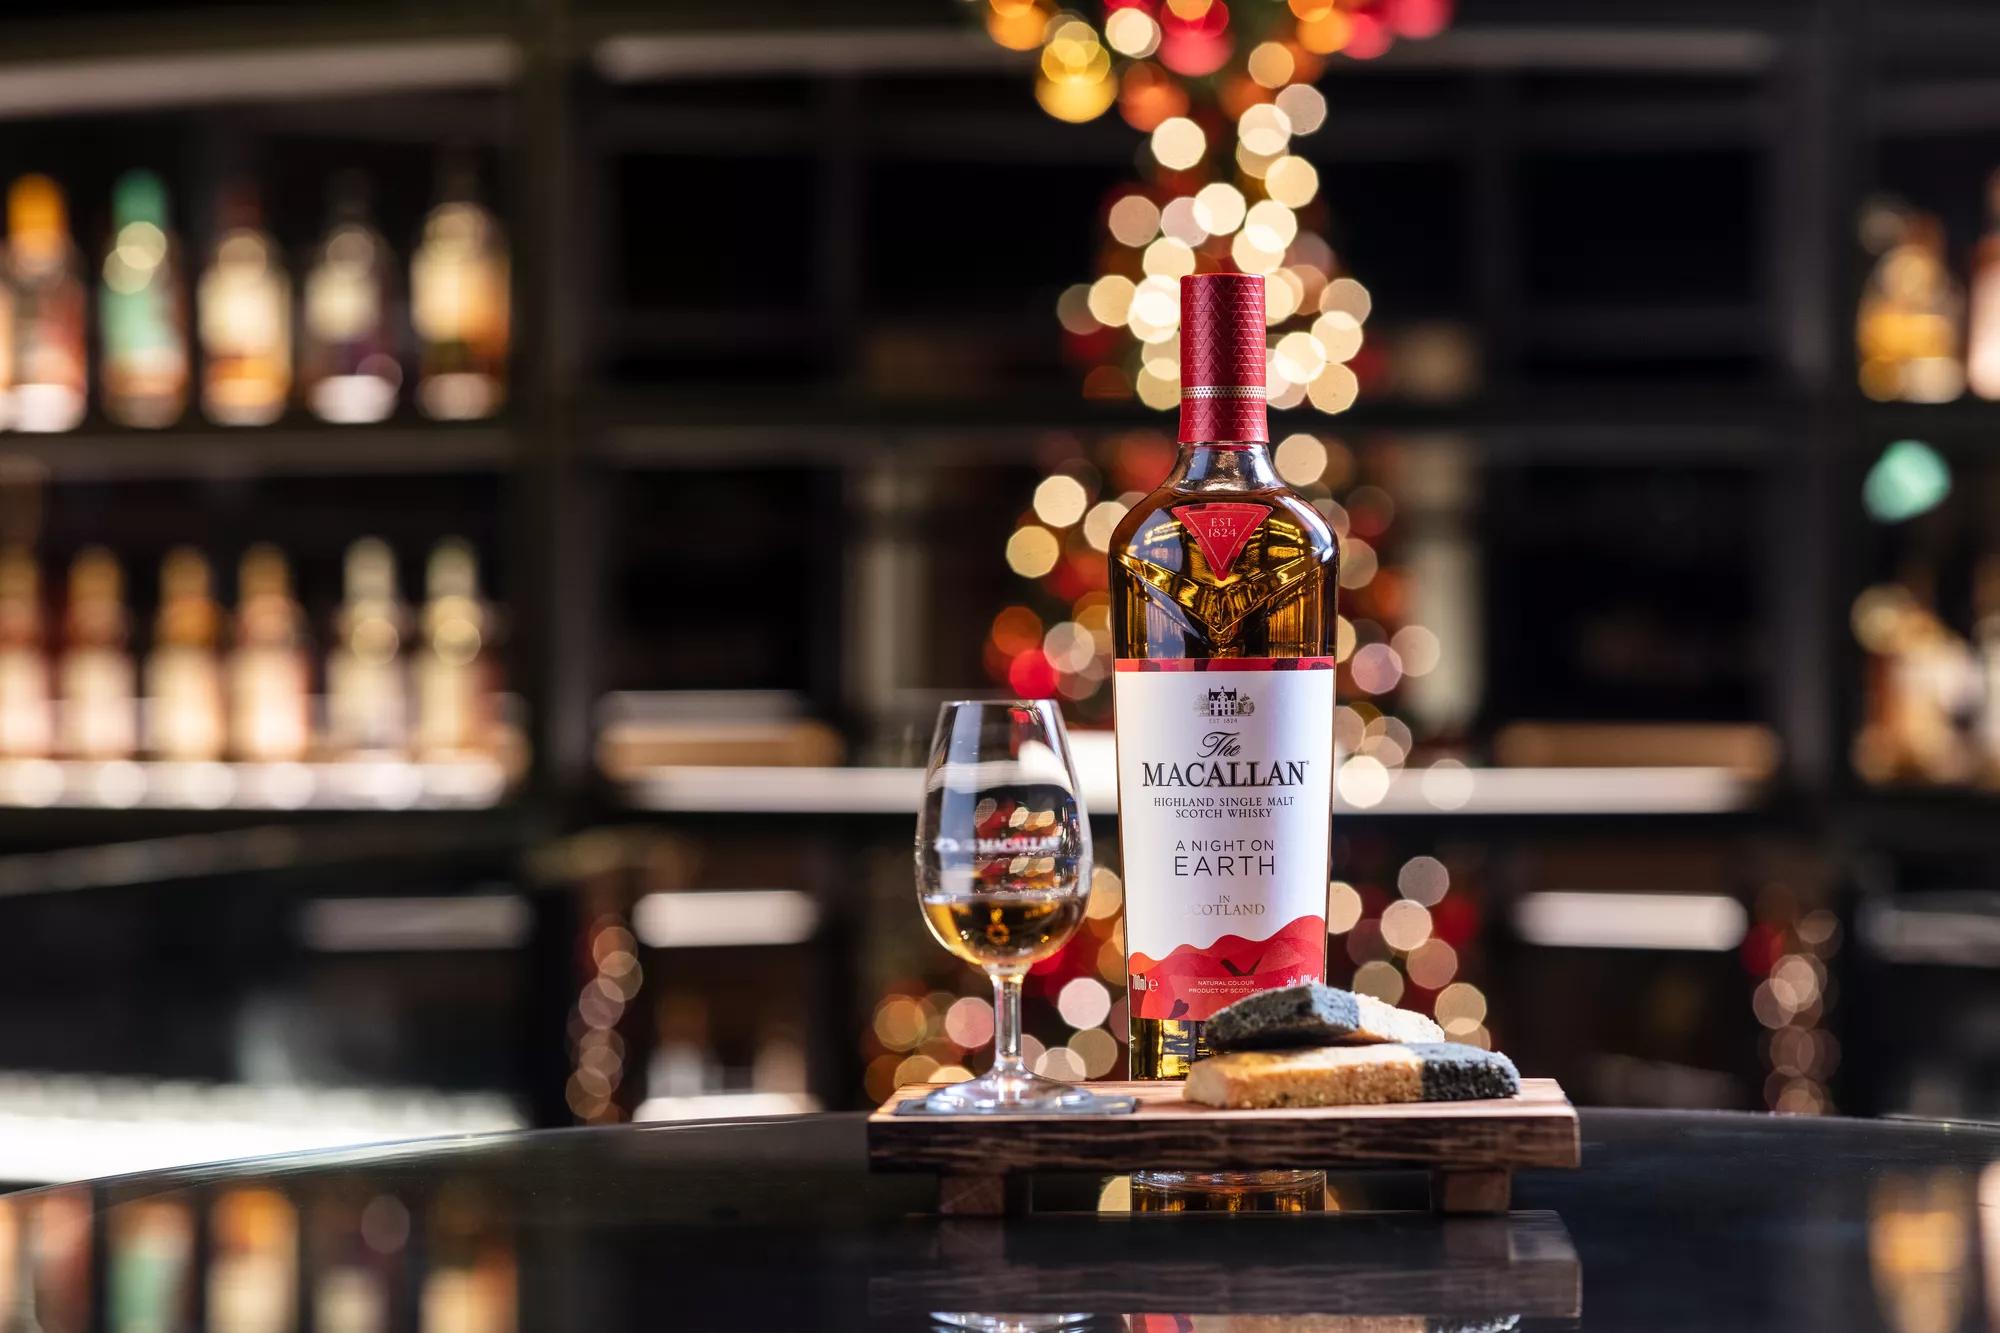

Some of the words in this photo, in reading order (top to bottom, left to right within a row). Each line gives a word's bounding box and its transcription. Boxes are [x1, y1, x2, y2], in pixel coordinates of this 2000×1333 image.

[1211, 518, 1236, 527] EST.
[1208, 528, 1237, 538] 1824
[1197, 731, 1240, 758] The
[1142, 761, 1306, 787] MACALLAN
[1154, 797, 1215, 807] HIGHLAND
[1219, 797, 1262, 806] SINGLE
[1267, 796, 1294, 806] MALT
[1175, 809, 1222, 819] SCOTCH
[1228, 808, 1273, 818] WHISKY
[1175, 840, 1186, 851] A
[1192, 840, 1245, 851] NIGHT
[1250, 839, 1274, 851] ON
[1174, 856, 1275, 876] EARTH
[1219, 895, 1231, 904] IN
[1187, 904, 1265, 916] COTLAND
